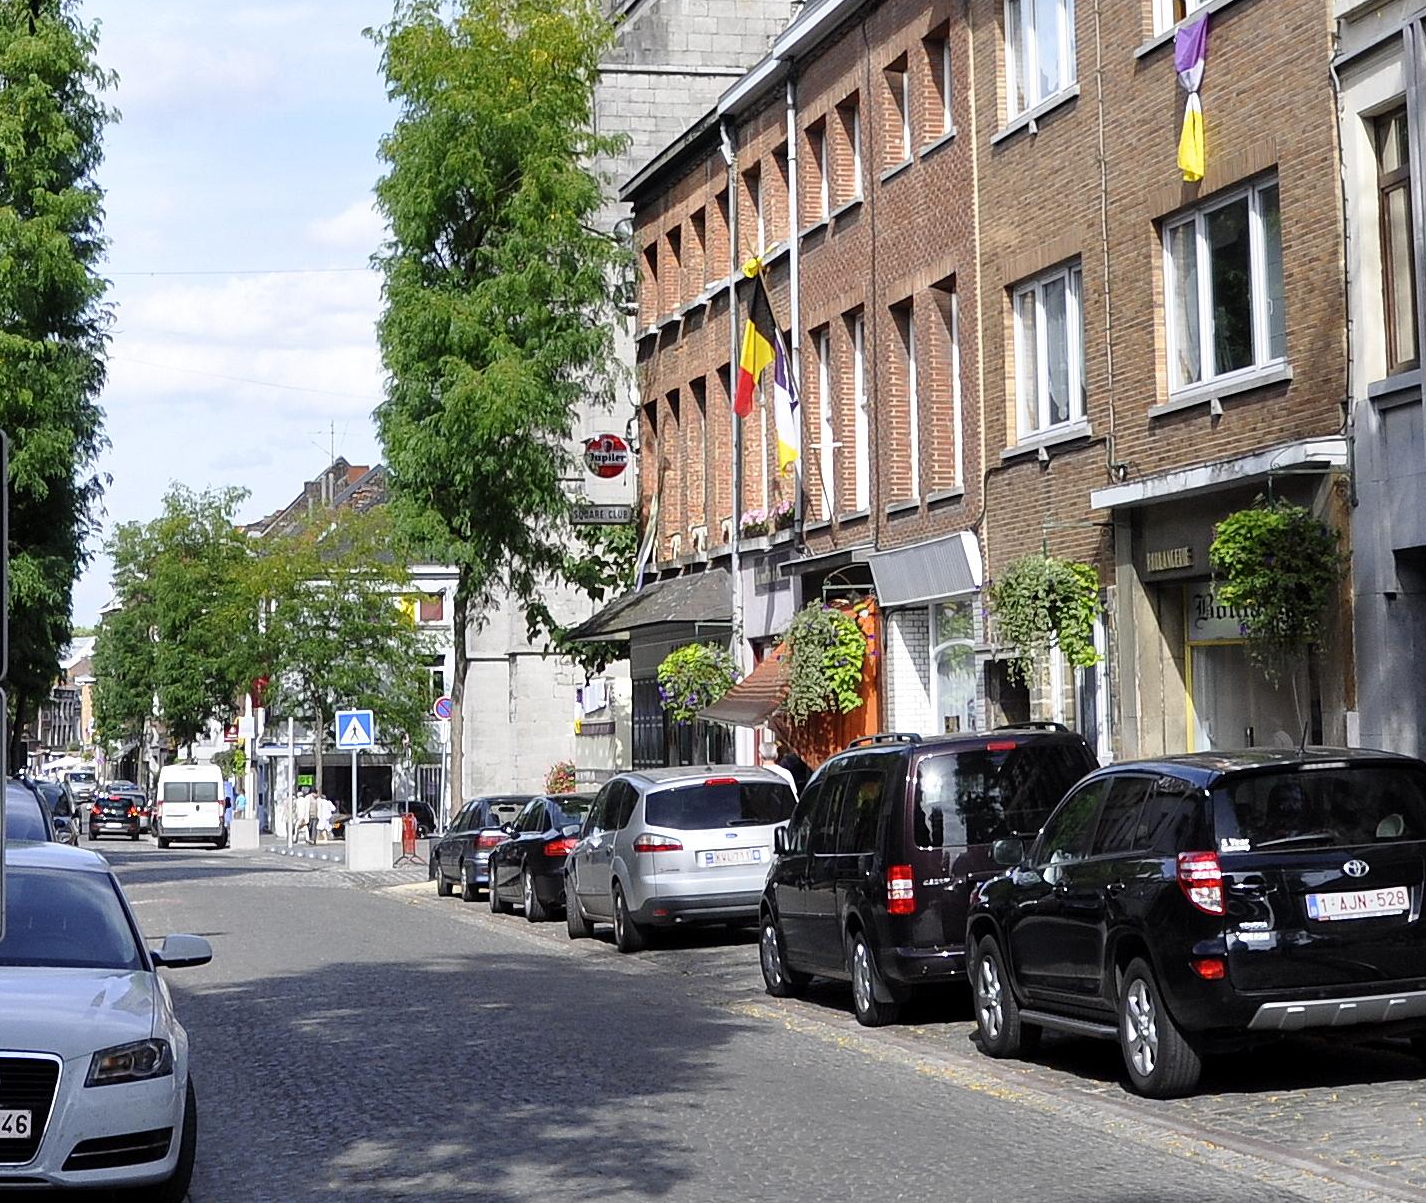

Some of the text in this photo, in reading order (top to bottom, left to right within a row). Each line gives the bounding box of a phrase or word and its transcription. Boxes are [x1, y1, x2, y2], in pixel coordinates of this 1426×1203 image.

[590, 452, 627, 464] Jupiler
[574, 509, 628, 520] SQUARE CLUB
